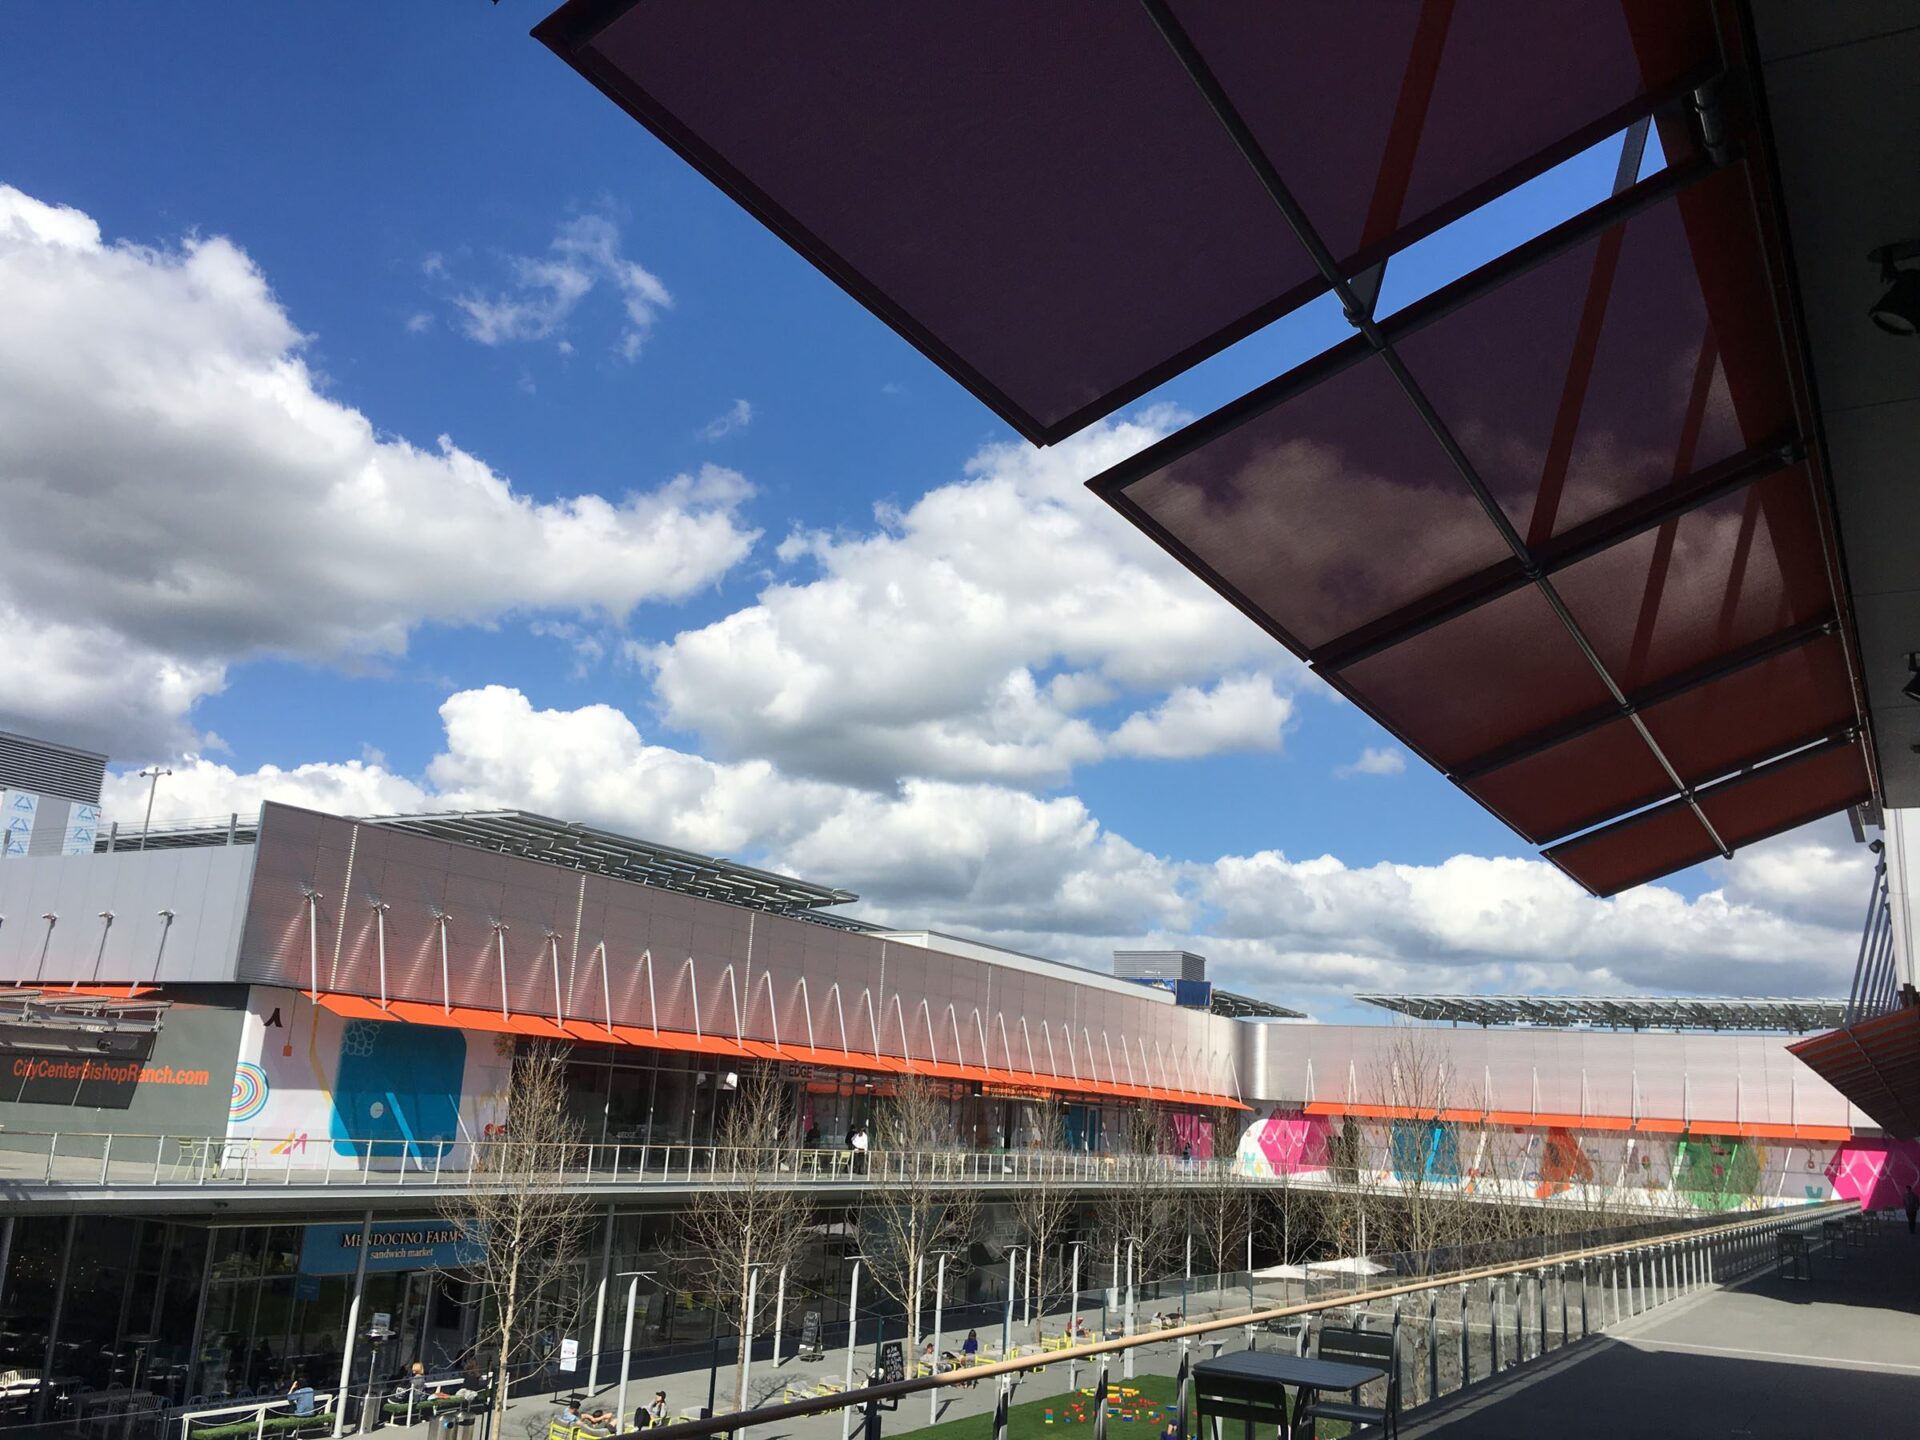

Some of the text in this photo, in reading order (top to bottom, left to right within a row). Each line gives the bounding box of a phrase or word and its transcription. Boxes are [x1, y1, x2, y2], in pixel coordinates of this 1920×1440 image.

[13, 1057, 210, 1086] CityCenterBishopRanch.com
[789, 1064, 814, 1079] EDGE
[426, 1230, 464, 1243] FARMS
[370, 1247, 434, 1260] sandwich market
